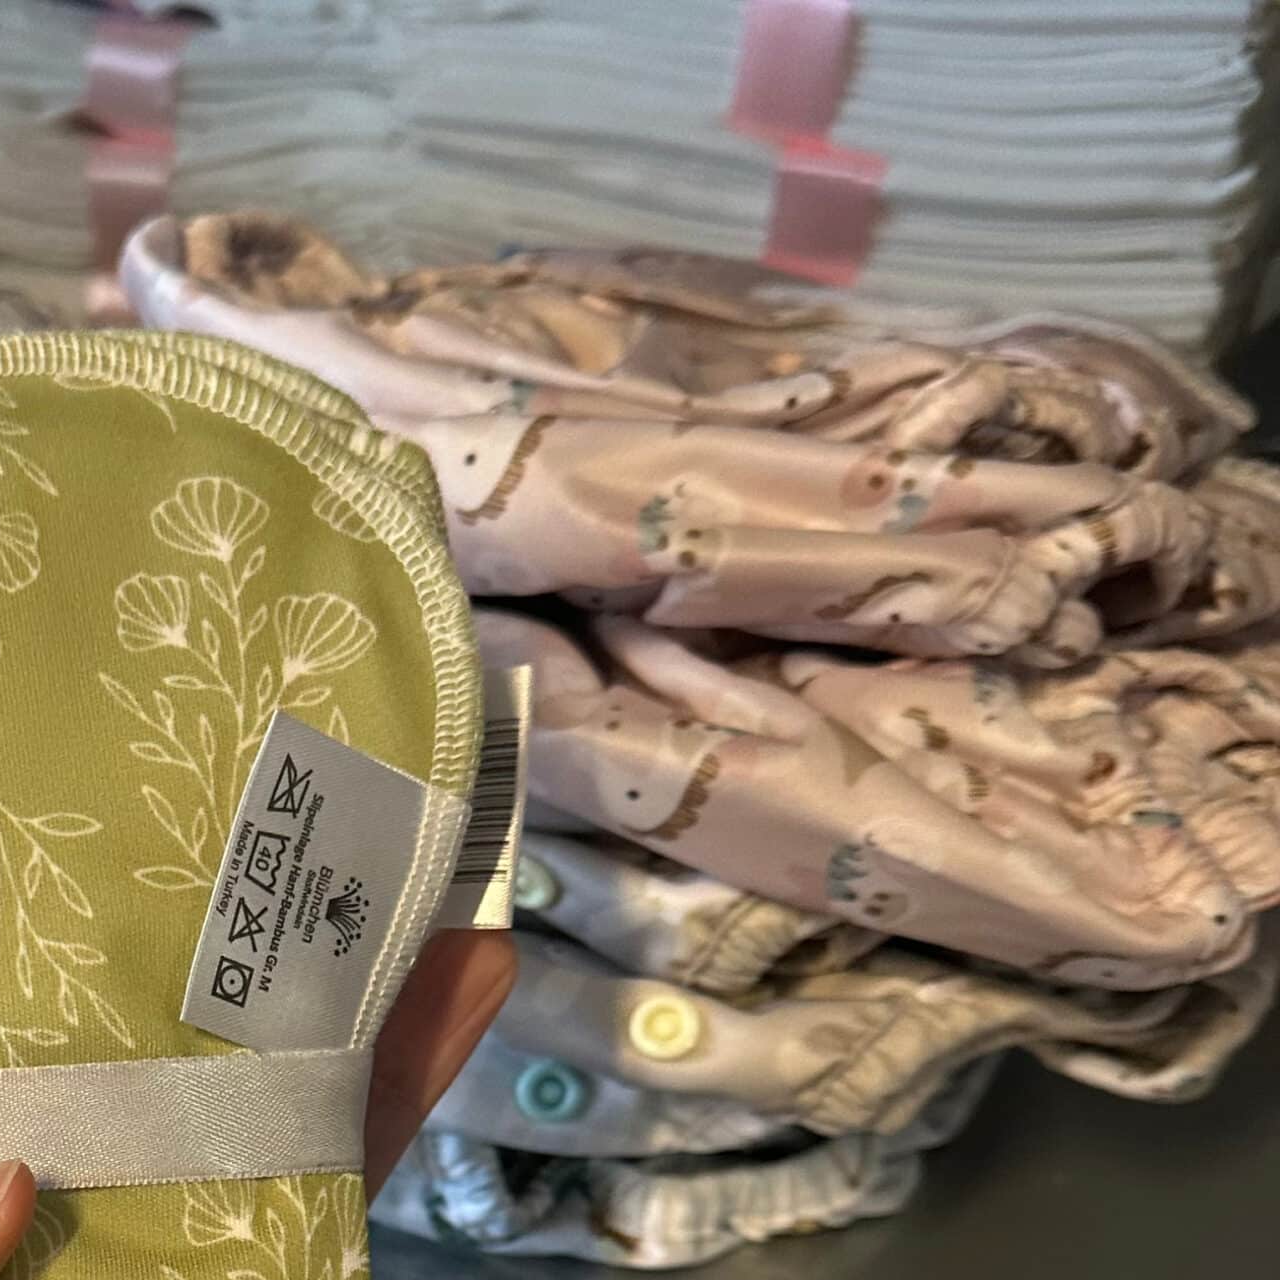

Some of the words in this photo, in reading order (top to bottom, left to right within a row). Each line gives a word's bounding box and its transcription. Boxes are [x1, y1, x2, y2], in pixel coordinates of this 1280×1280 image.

[235, 820, 255, 856] Made
[294, 793, 324, 863] Slipeinlage
[230, 858, 244, 872] in
[255, 845, 272, 872] 40
[215, 874, 239, 918] Turkey
[270, 864, 302, 952] Hanf-Bambus
[302, 866, 334, 944] Blümchen
[263, 954, 278, 973] Gr.
[258, 975, 272, 992] M
